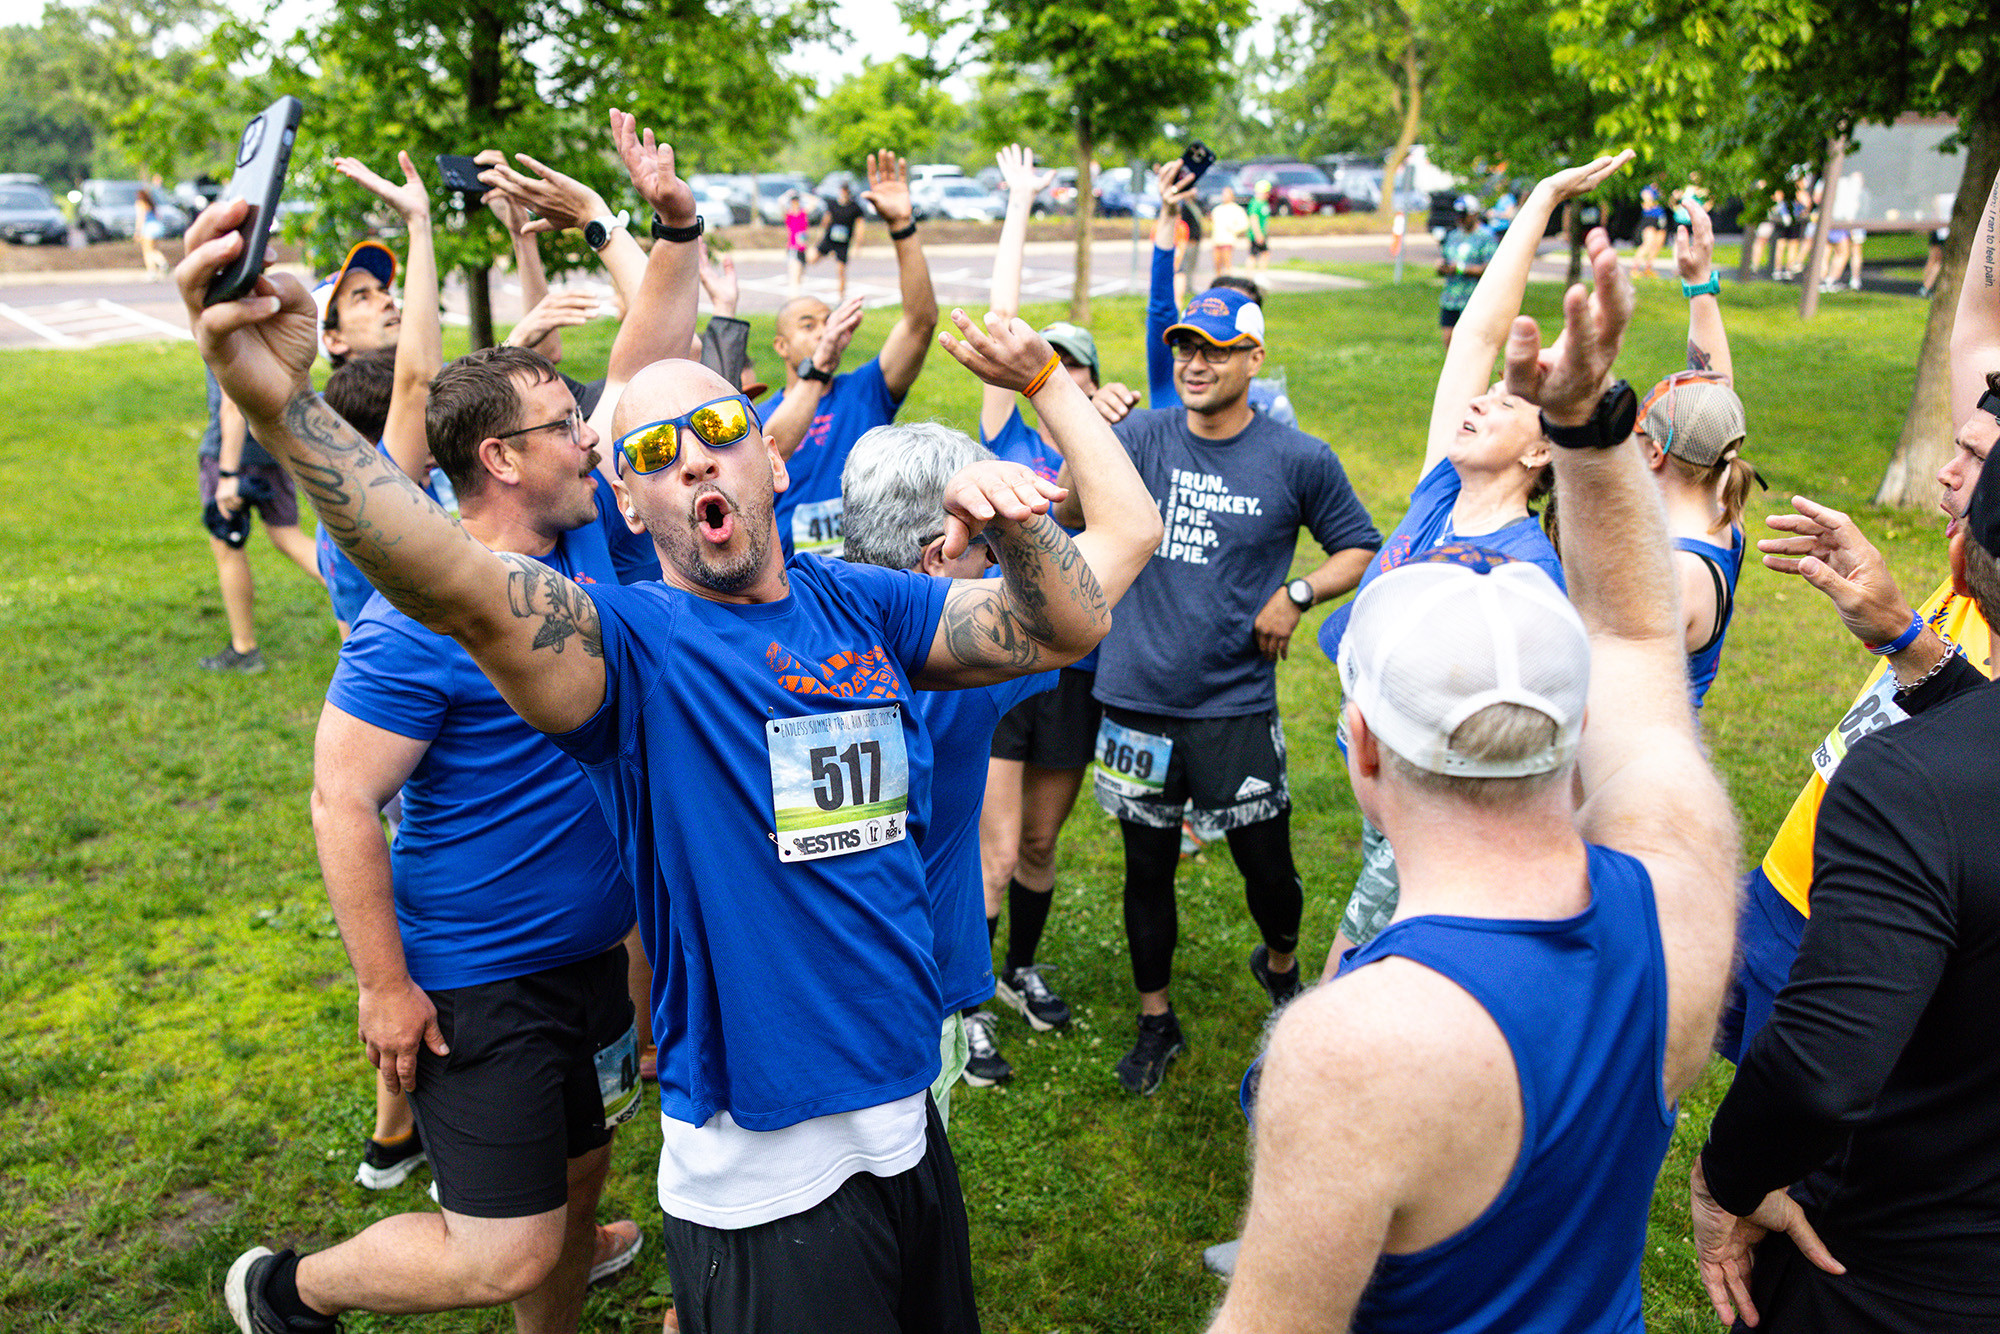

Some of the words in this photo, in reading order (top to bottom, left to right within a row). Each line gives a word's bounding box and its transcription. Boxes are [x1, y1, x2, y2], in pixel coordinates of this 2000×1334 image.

[1987, 216, 1995, 233] ran
[1986, 235, 1995, 244] to
[1986, 247, 1996, 264] feel
[1180, 470, 1229, 494] RUN.
[1178, 487, 1263, 516] TURKEY.
[1175, 505, 1213, 528] PIE.
[1172, 524, 1220, 548] NAP.
[1169, 542, 1209, 565] PIE.
[780, 721, 809, 738] ENDLESS
[809, 717, 832, 735] SUMMER
[851, 714, 862, 729] RUN
[862, 713, 879, 728] SERIES
[879, 711, 893, 726] 2025
[1104, 738, 1153, 779] 869
[809, 740, 881, 811] 517
